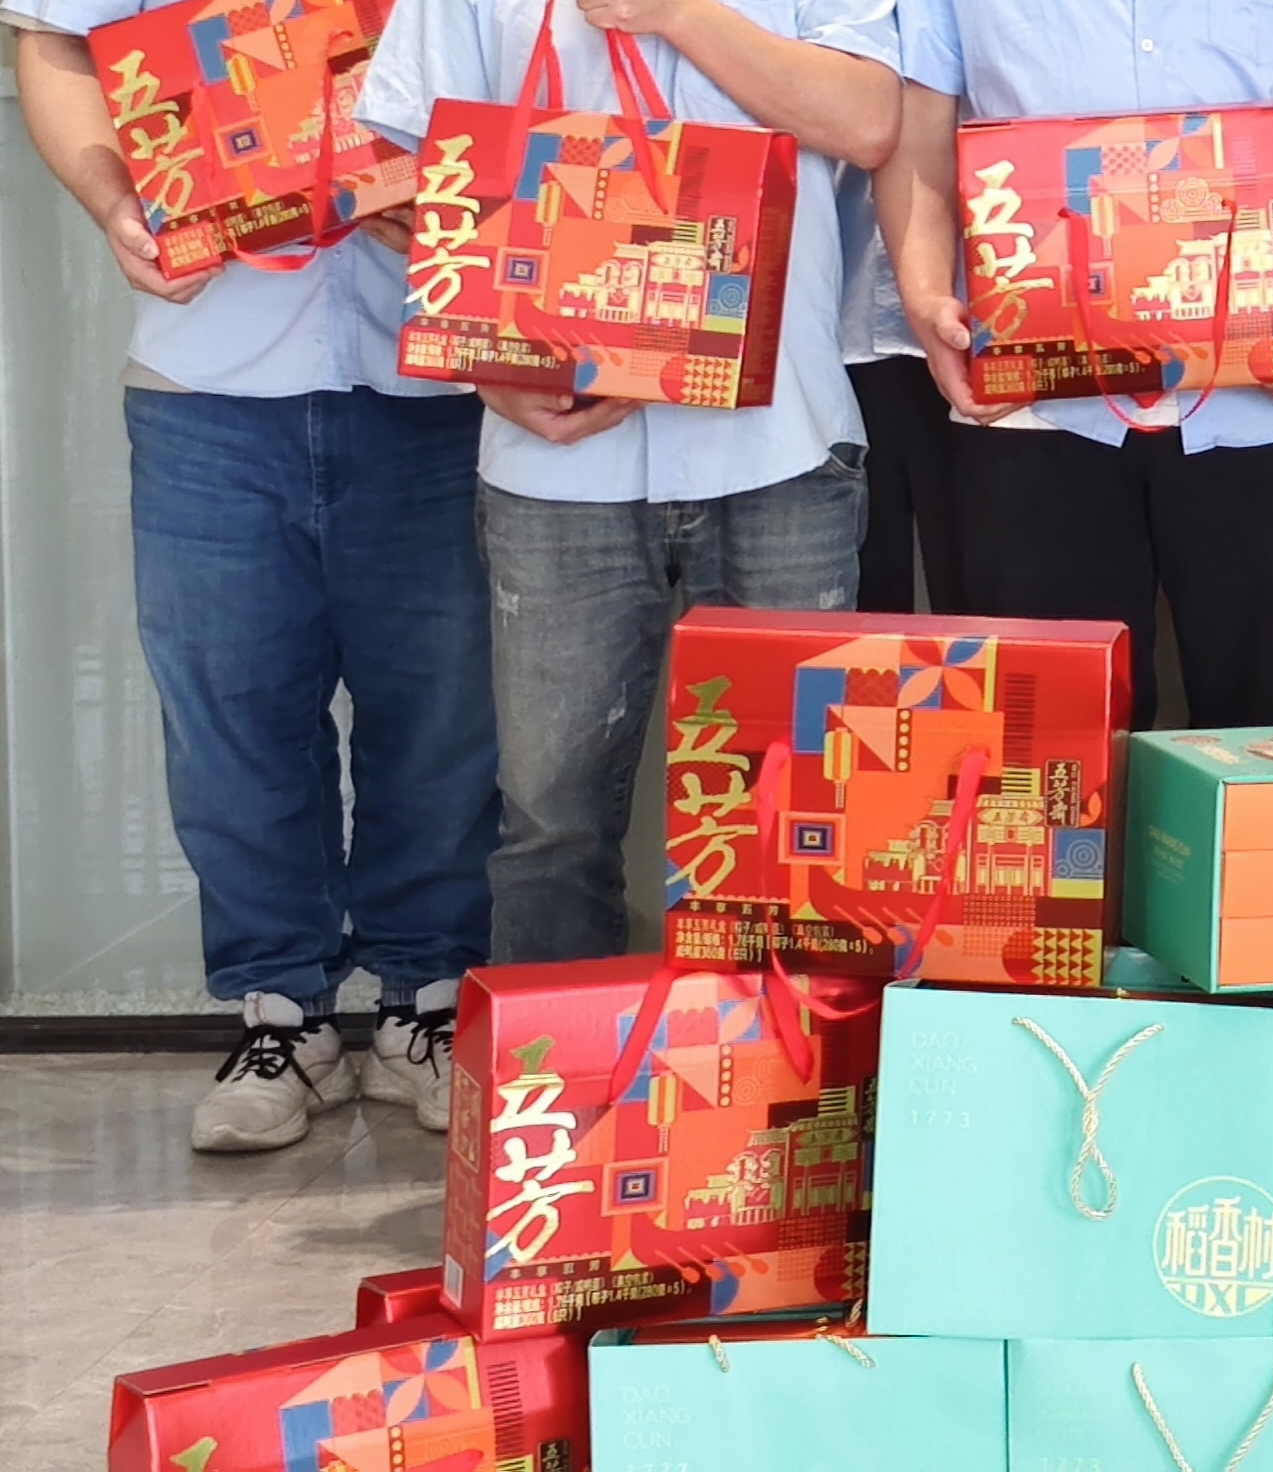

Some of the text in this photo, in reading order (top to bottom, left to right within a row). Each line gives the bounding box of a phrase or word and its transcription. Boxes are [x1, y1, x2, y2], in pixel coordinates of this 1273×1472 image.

[110, 50, 203, 220] 五芳
[406, 134, 490, 314] 五芳
[964, 160, 1054, 342] 五芳
[665, 674, 758, 896] 五芳
[911, 1031, 960, 1050] DAO
[910, 1053, 977, 1076] XIANG
[908, 1077, 957, 1096] CUN
[910, 1110, 971, 1129] 1773
[484, 1035, 594, 1263] 五芳
[621, 1386, 671, 1403] DAO
[622, 1408, 693, 1425] XIANG
[622, 1431, 672, 1449] CUN
